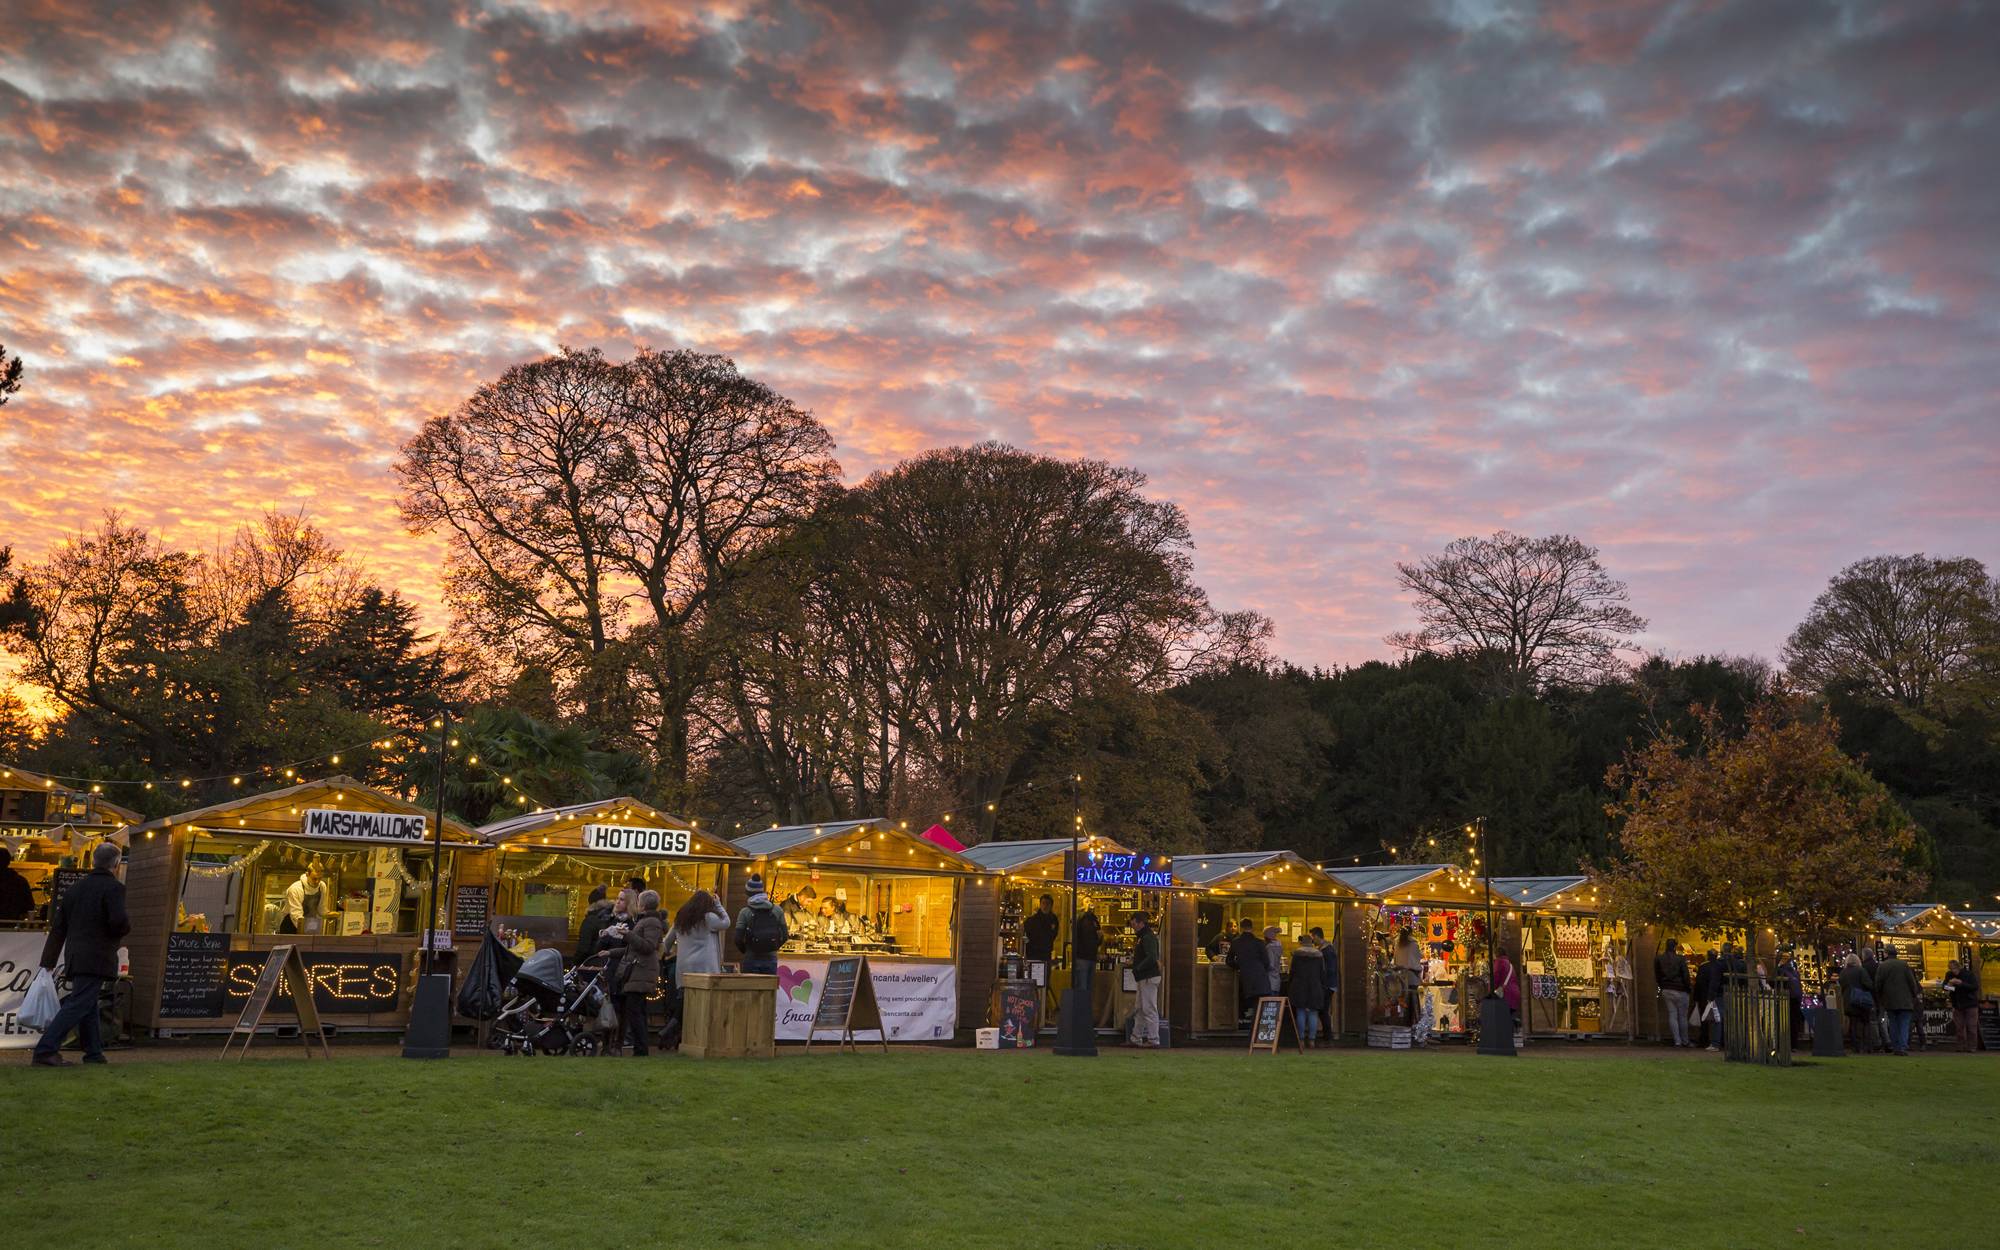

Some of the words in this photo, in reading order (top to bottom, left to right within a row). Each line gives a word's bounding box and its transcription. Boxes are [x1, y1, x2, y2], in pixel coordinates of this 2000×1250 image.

[310, 812, 424, 840] MARSHMALLOWS
[595, 827, 687, 853] HOTDOGS
[1102, 853, 1137, 869] HOT
[1076, 866, 1134, 885] GINGER
[1136, 870, 1172, 886] WINE
[872, 974, 900, 982] ncanta
[901, 974, 939, 984] Jewellery
